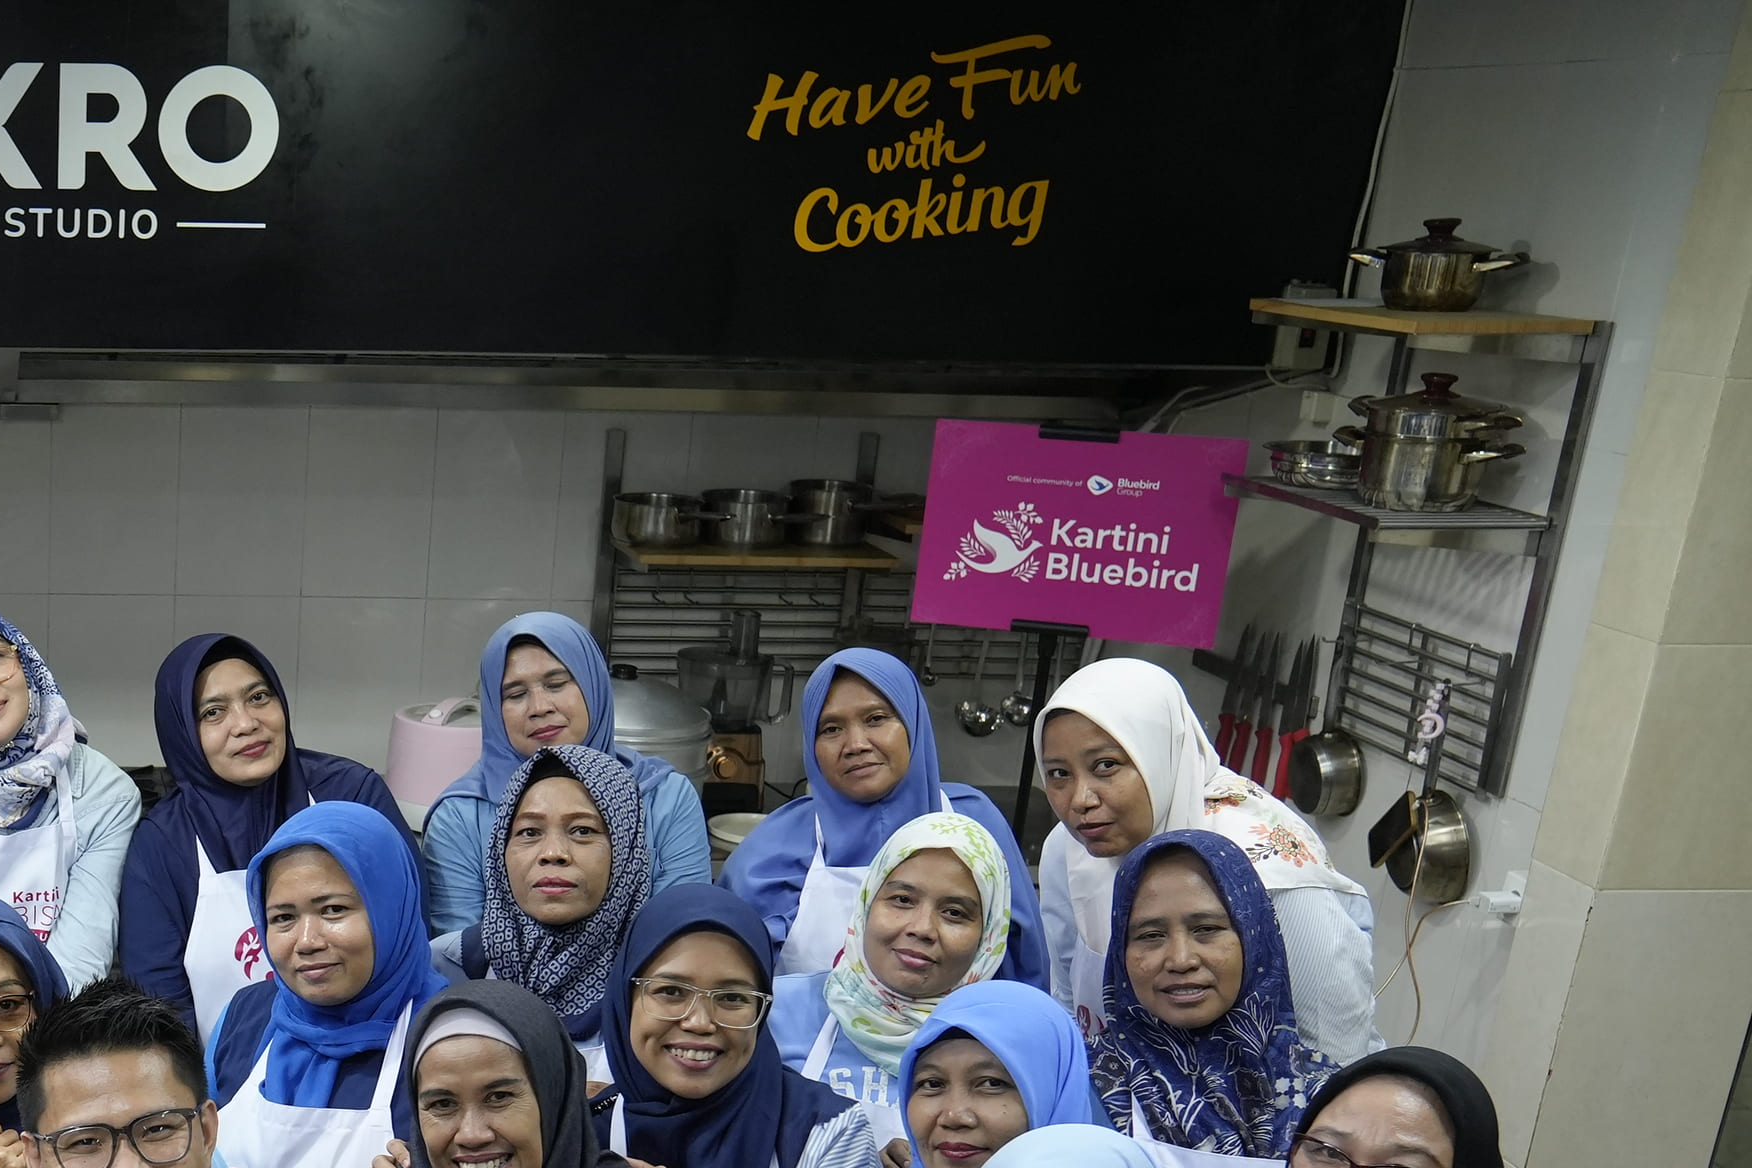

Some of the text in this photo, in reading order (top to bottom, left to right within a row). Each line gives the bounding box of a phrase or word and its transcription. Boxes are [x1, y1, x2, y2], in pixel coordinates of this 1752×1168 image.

[747, 34, 1081, 141] Have Fun
[867, 119, 986, 174] with
[3, 207, 159, 240] STUDIO
[794, 173, 1050, 253] Cooking
[1007, 475, 1032, 484] Official
[1032, 477, 1073, 487] community
[1116, 488, 1143, 498] Group
[1117, 478, 1161, 490] Bluebird
[1050, 518, 1171, 555] Kartini
[1045, 552, 1200, 592] Bluebird
[829, 1066, 900, 1108] SH
